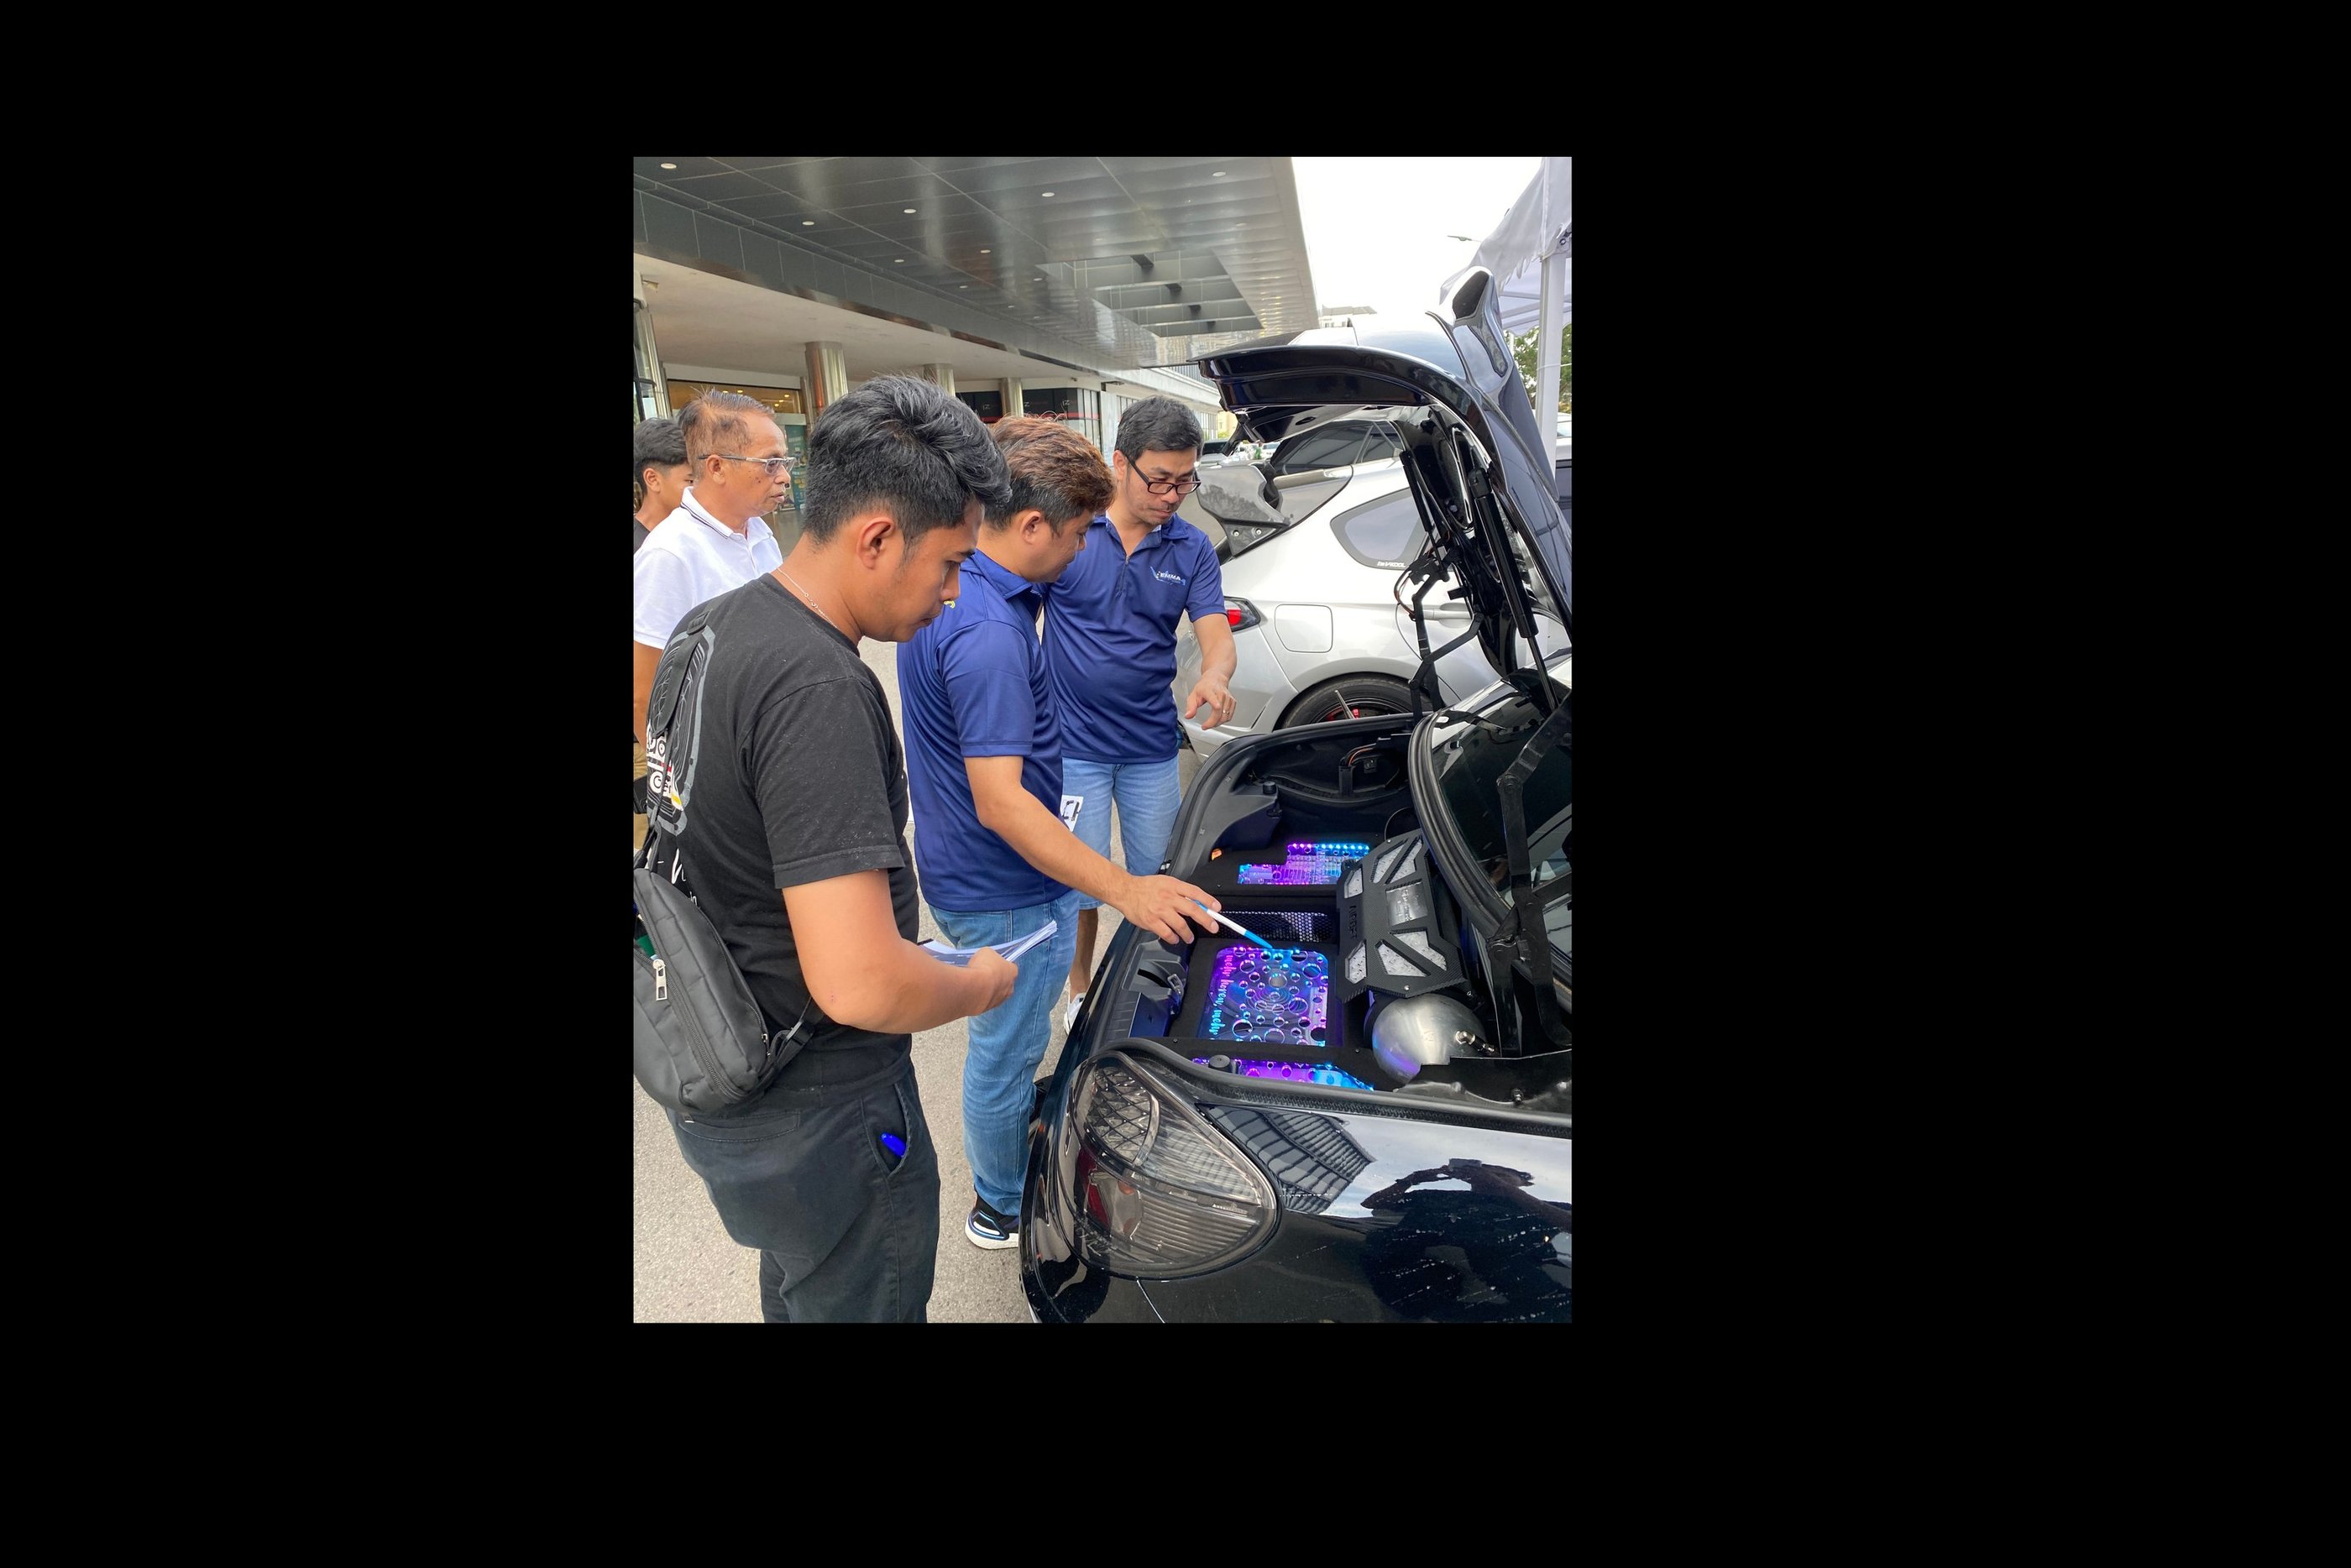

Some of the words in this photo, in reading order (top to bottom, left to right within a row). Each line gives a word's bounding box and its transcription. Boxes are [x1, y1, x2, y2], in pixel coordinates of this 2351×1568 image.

[1160, 572, 1181, 581] EMMA
[1222, 954, 1237, 977] mehr
[1208, 1009, 1226, 1036] mehr
